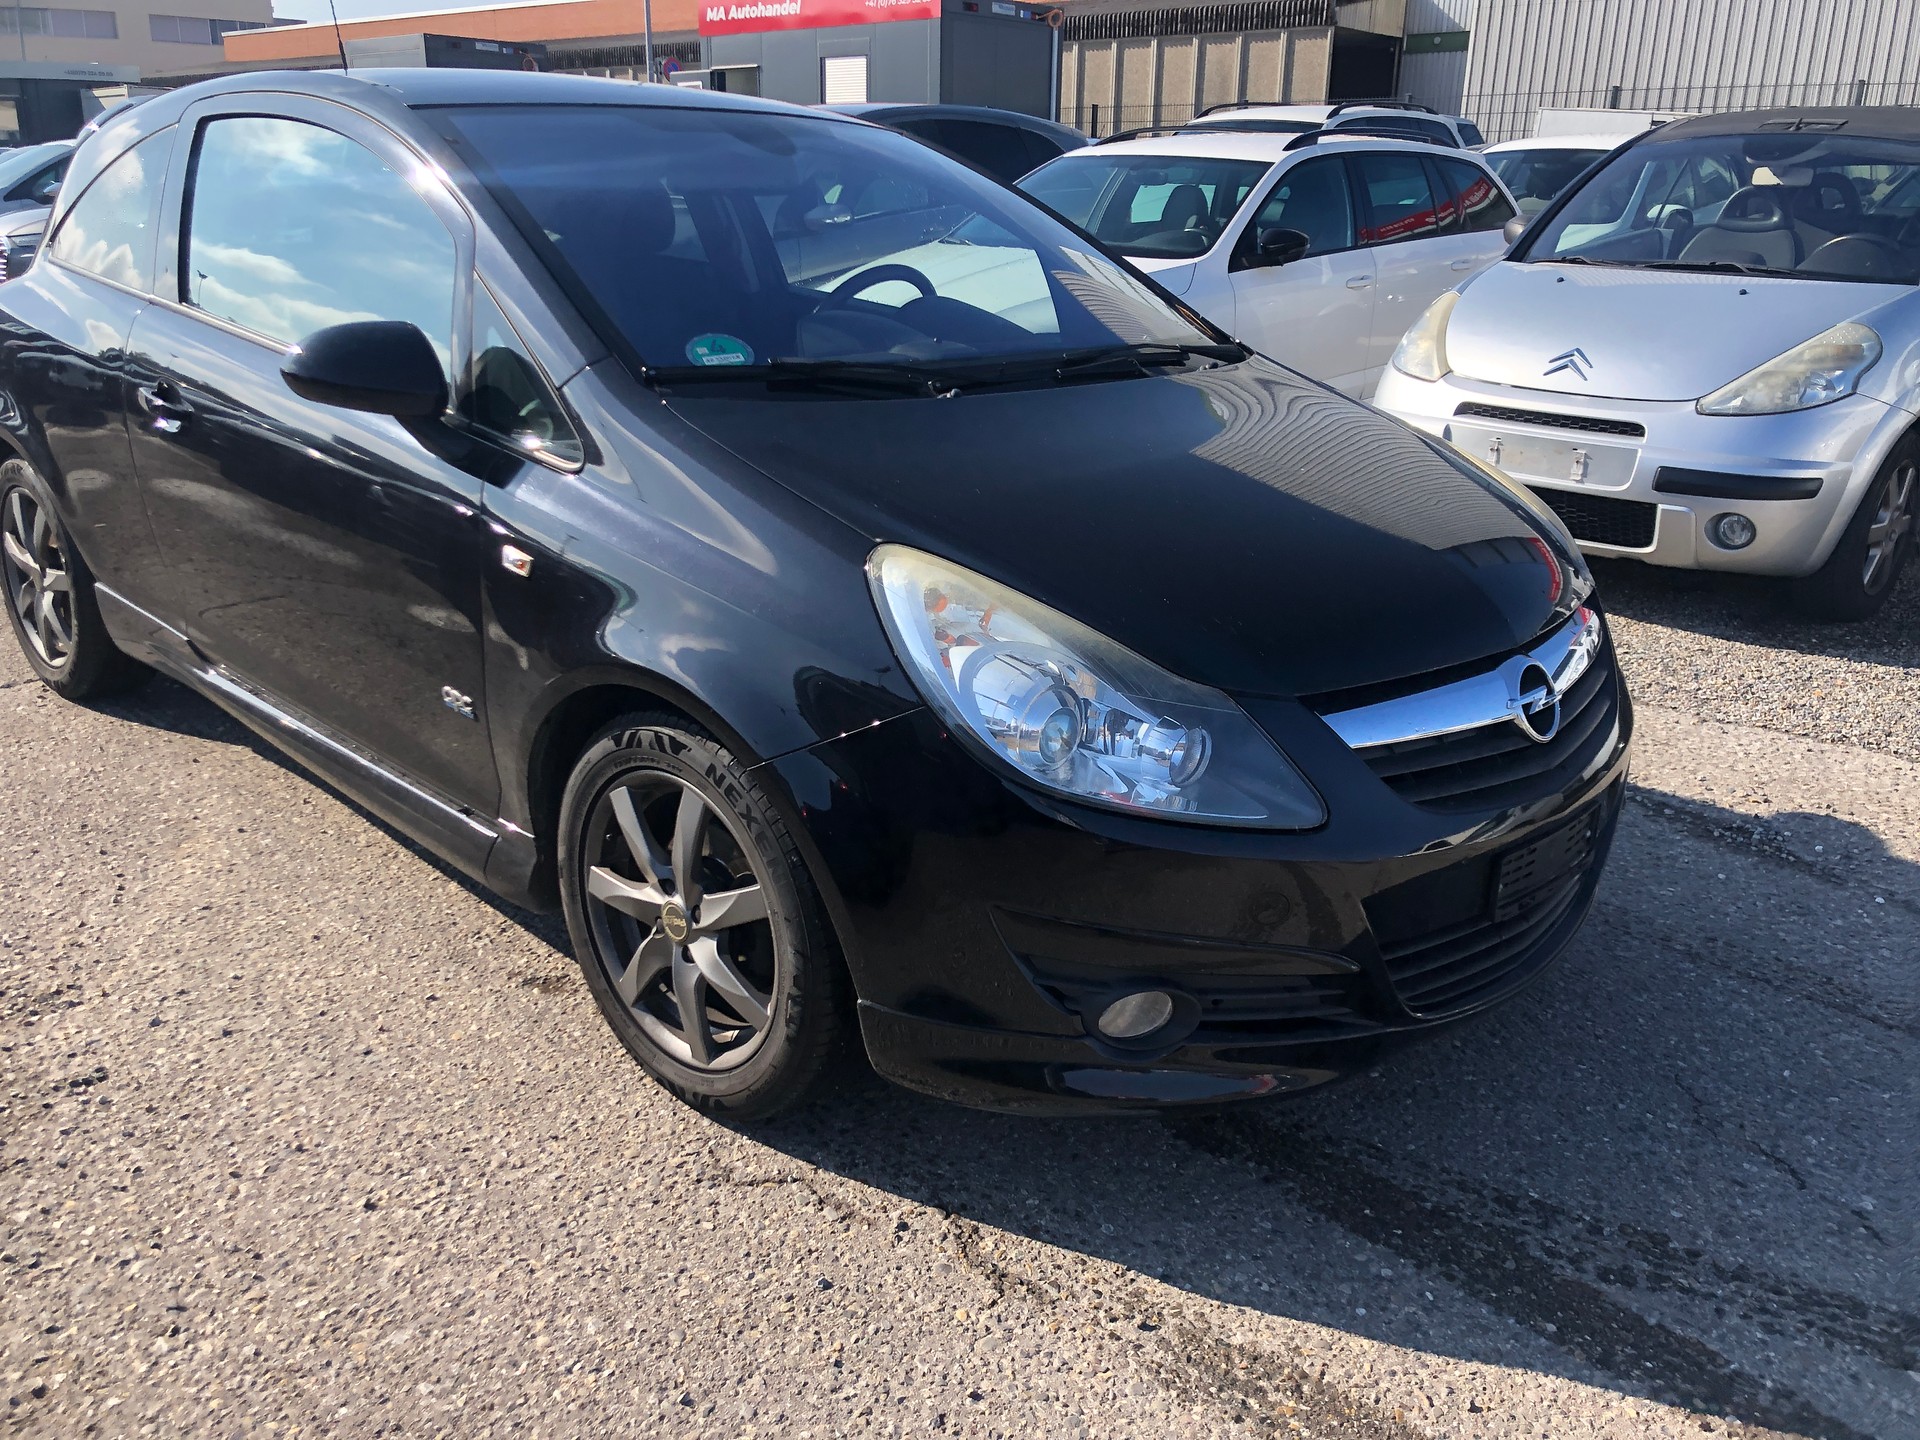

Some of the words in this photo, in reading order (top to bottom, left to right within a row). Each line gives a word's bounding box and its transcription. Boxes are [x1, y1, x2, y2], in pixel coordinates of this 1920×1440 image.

[706, 6, 727, 22] MA
[728, 0, 801, 20] Autohandel
[705, 763, 788, 888] NEXEN
